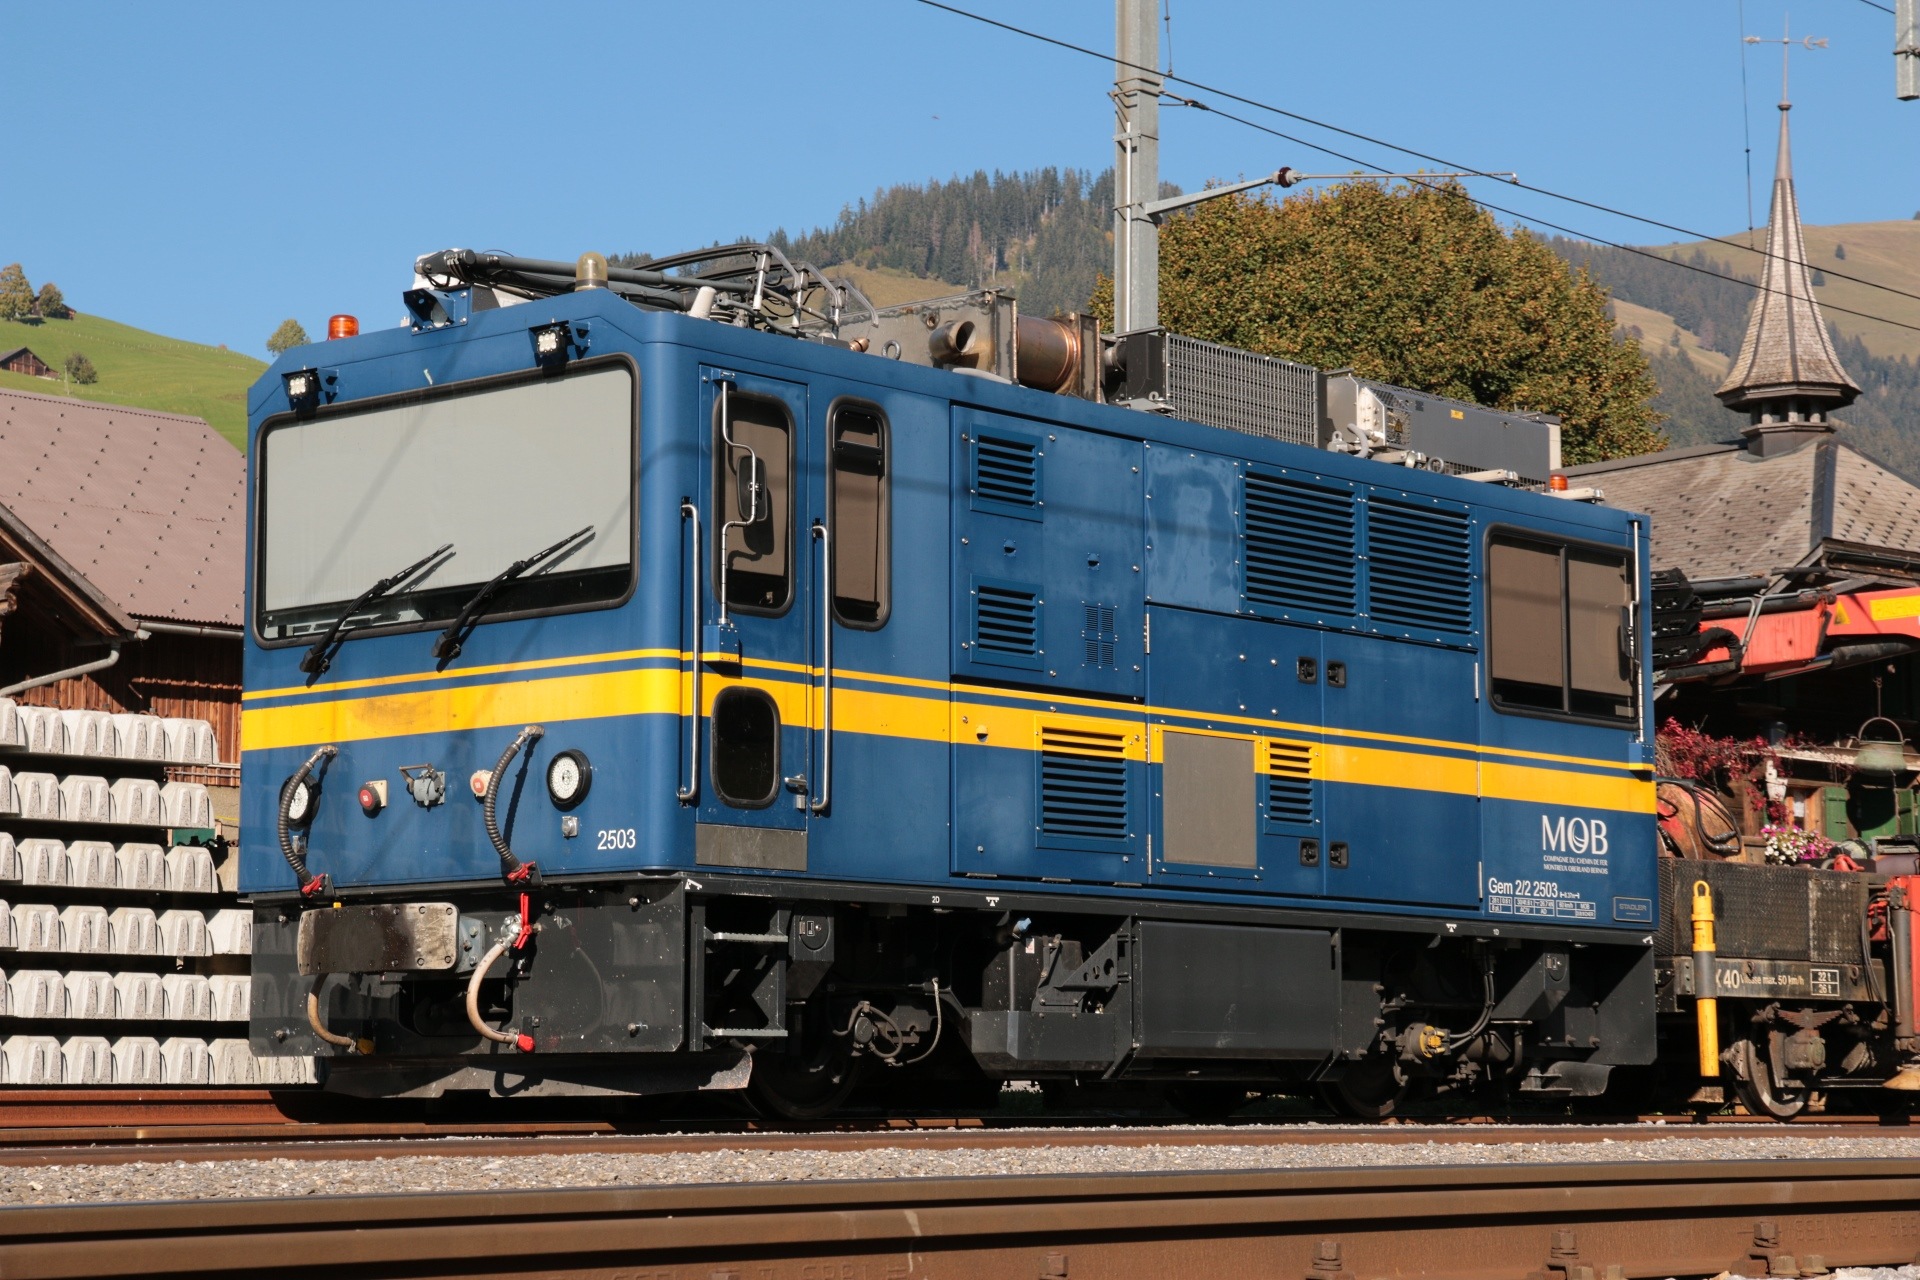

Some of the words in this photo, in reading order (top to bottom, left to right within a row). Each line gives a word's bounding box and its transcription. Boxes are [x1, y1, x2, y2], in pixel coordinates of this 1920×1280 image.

[597, 828, 636, 850] 2503
[1542, 815, 1608, 855] MOB
[1543, 864, 1568, 872] MONTREUX
[1568, 865, 1590, 873] OBERLAND
[1590, 867, 1608, 875] BERNOIS
[1488, 877, 1513, 895] Gem
[1515, 880, 1531, 896] 2/2
[1533, 881, 1558, 898] 2503
[1619, 903, 1647, 911] STADLER
[1723, 969, 1740, 989] 40
[1762, 976, 1777, 985] max.
[1777, 975, 1787, 985] 50
[1788, 975, 1805, 986] km/h
